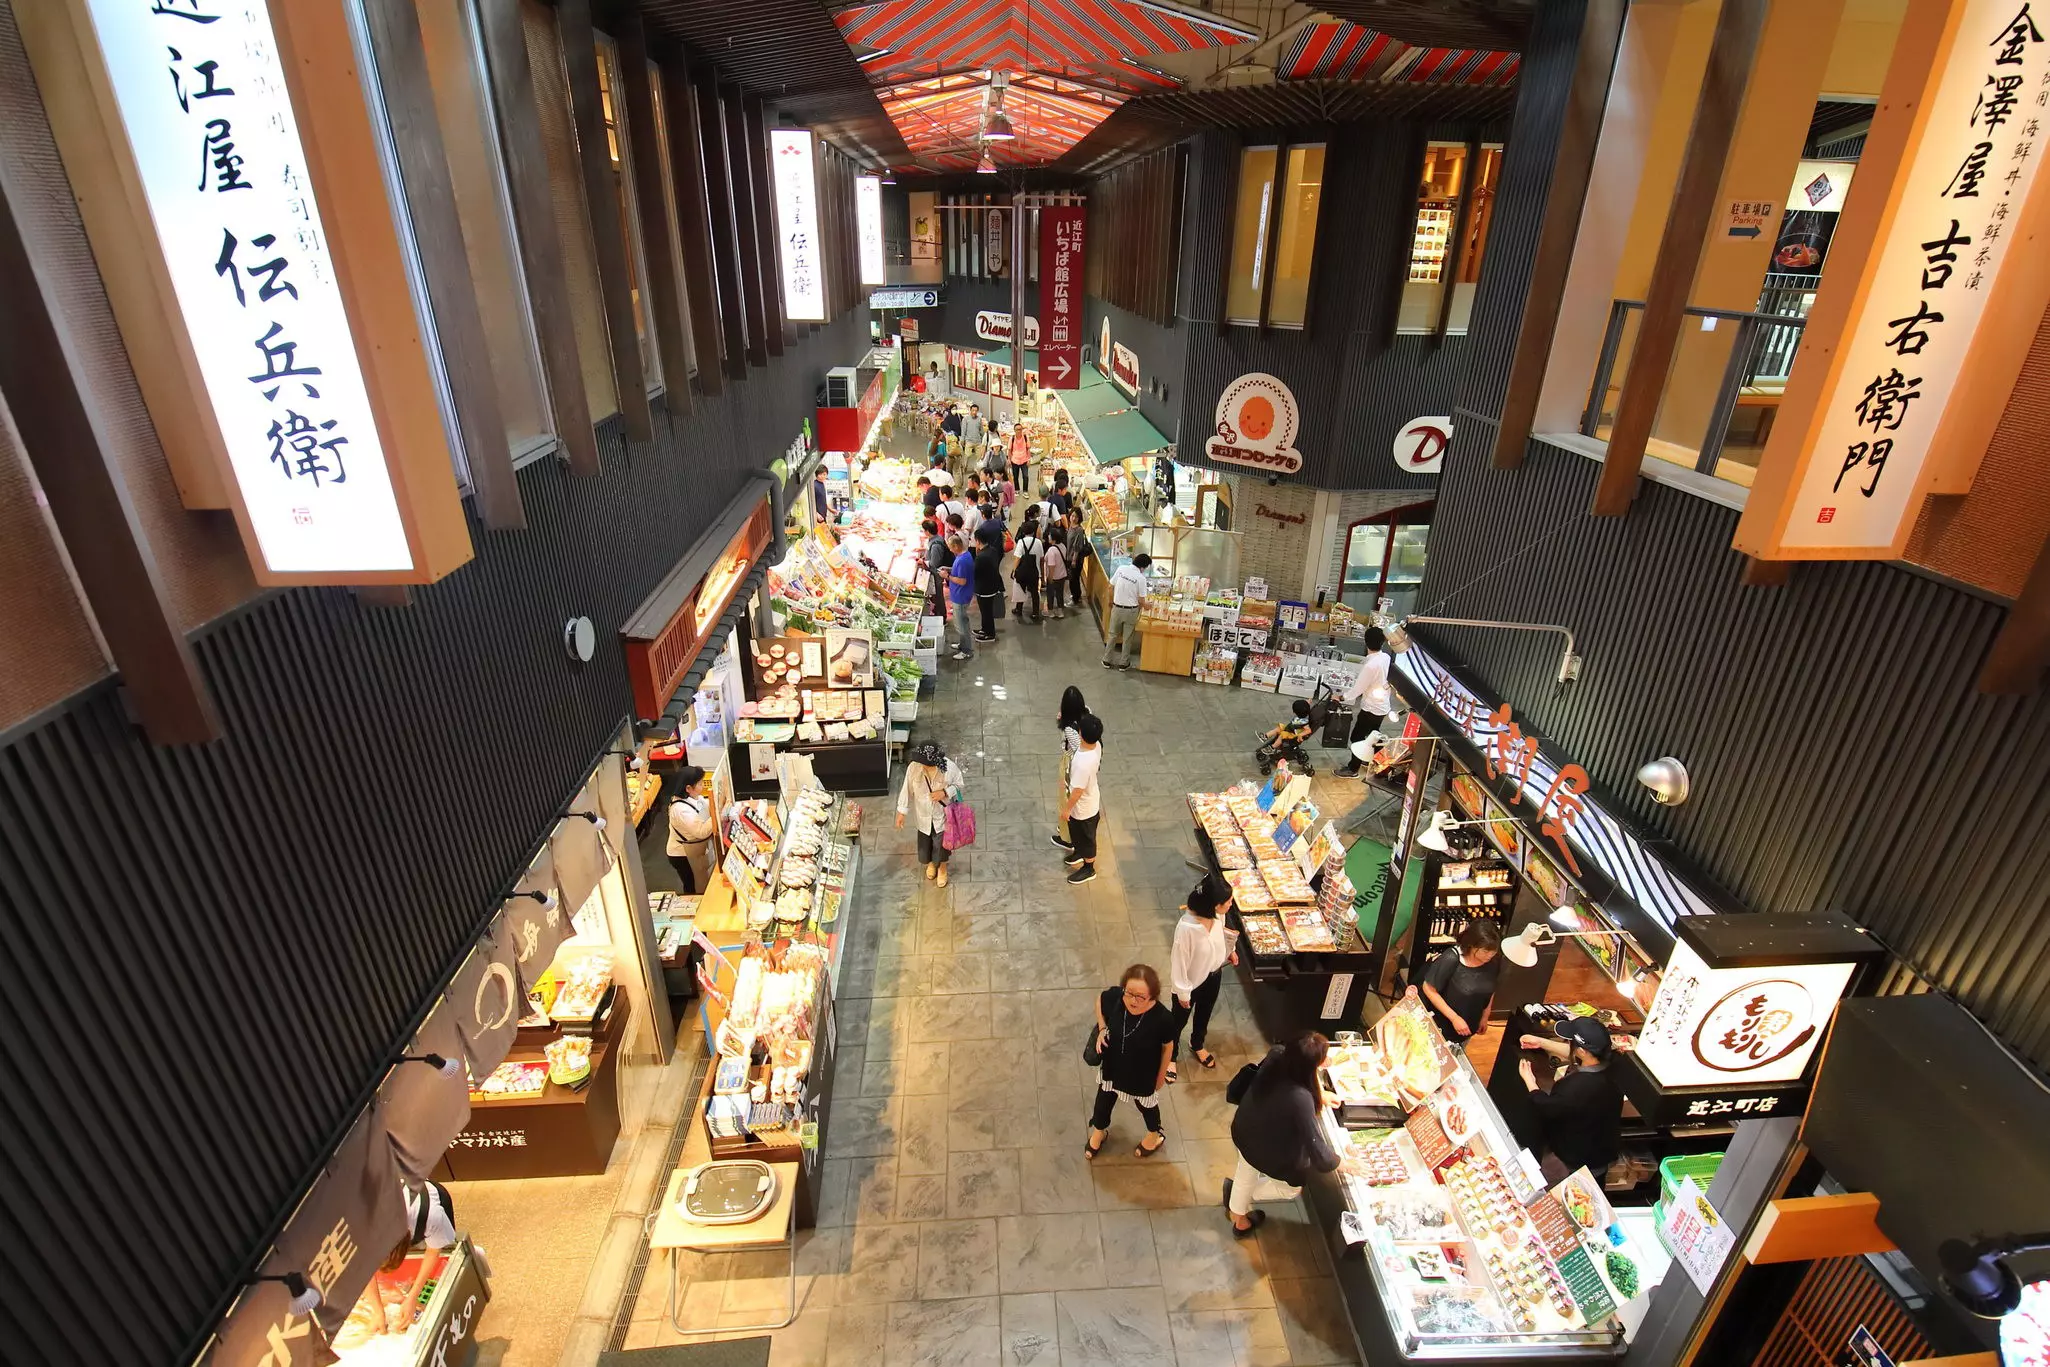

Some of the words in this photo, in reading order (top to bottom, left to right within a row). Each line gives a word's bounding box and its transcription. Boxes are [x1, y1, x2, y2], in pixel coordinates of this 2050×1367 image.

[1732, 216, 1762, 225] Parking
[1071, 220, 1082, 253] 近江町
[1834, 4, 2044, 497] 金澤屋吉右衛門
[1054, 221, 1070, 314] いちば館広場
[978, 315, 1013, 338] Diamo
[1219, 422, 1235, 442] 金沢
[1210, 629, 1252, 645] ほたて
[1352, 861, 1391, 908] Welcom
[1687, 1097, 1779, 1116] 近江町店
